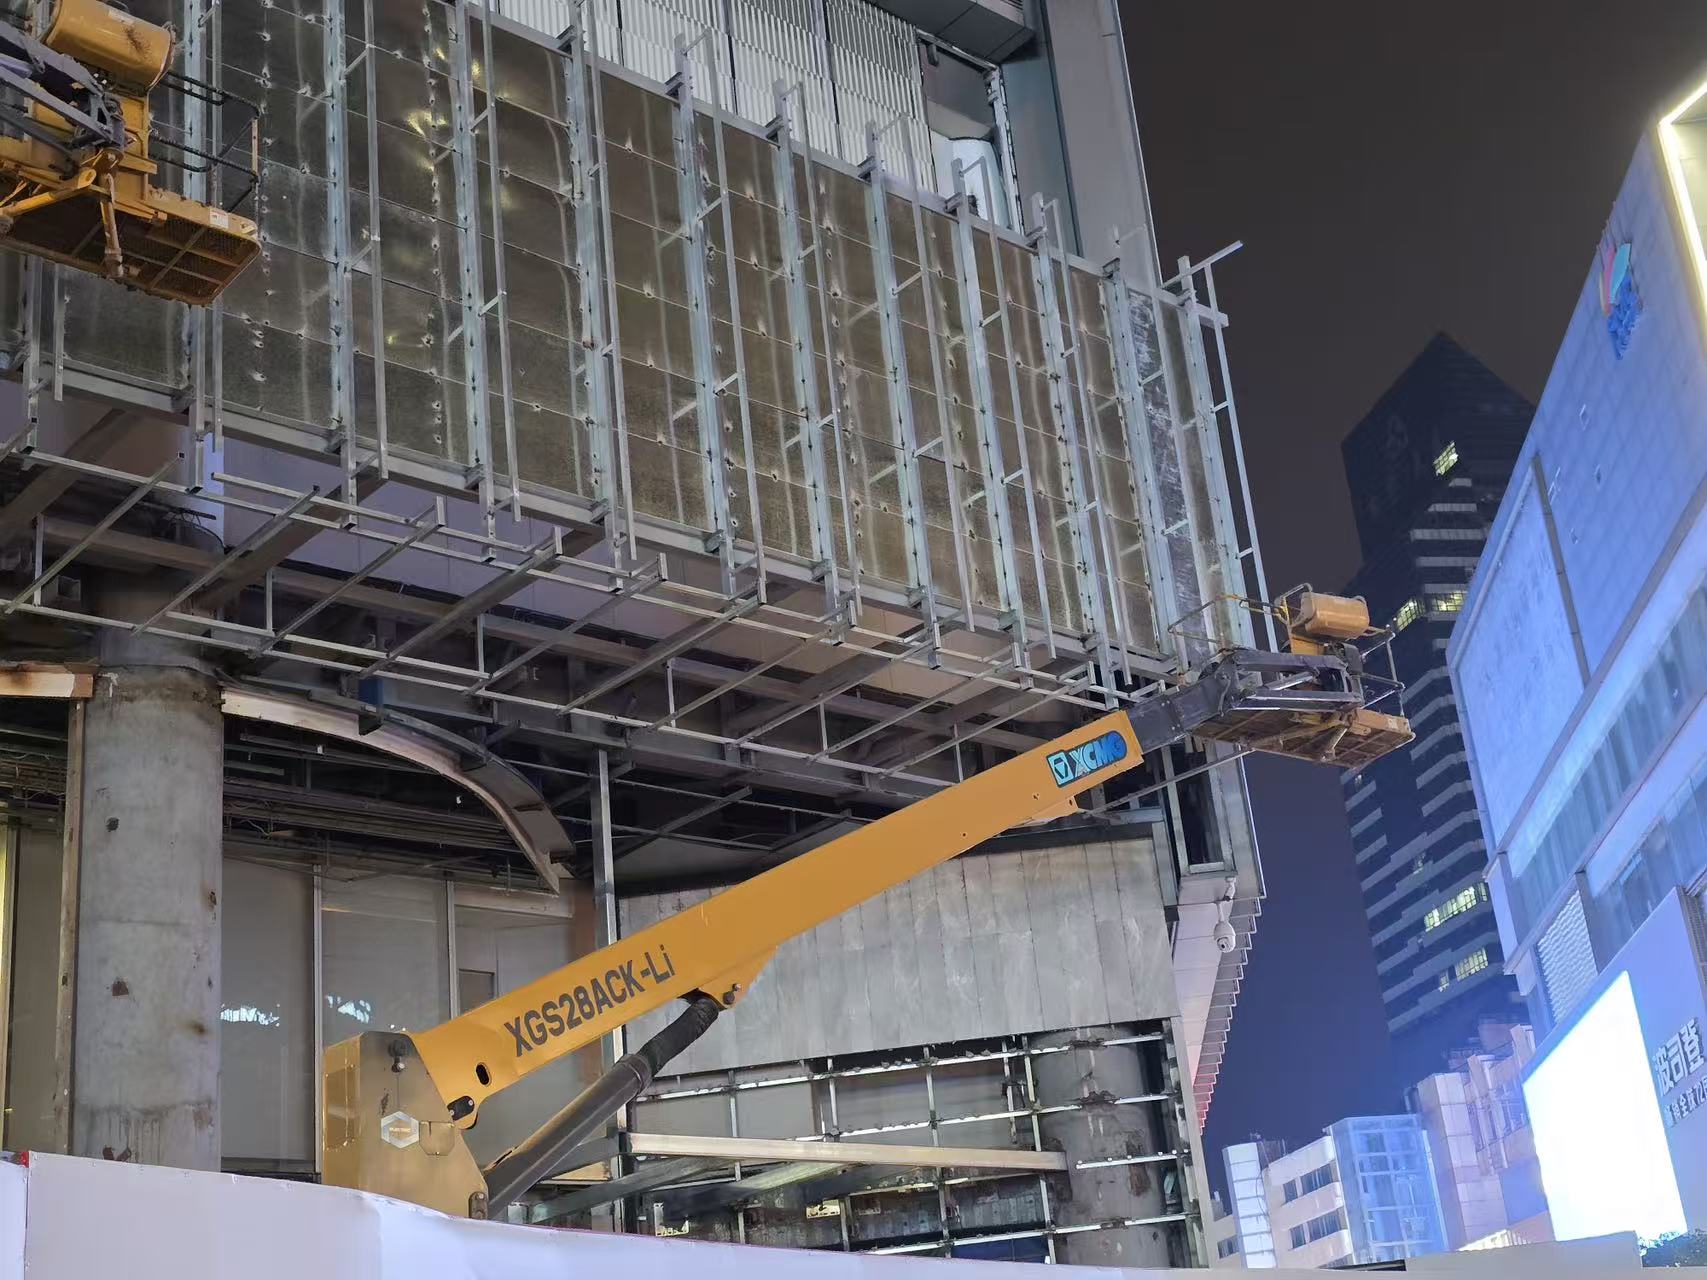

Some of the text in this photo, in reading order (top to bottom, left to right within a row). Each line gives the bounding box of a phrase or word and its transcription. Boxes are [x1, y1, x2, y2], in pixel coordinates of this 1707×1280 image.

[1068, 730, 1128, 778] XCMG
[503, 944, 676, 1057] XGS28ACK-Li
[1652, 1018, 1705, 1098] 波司登
